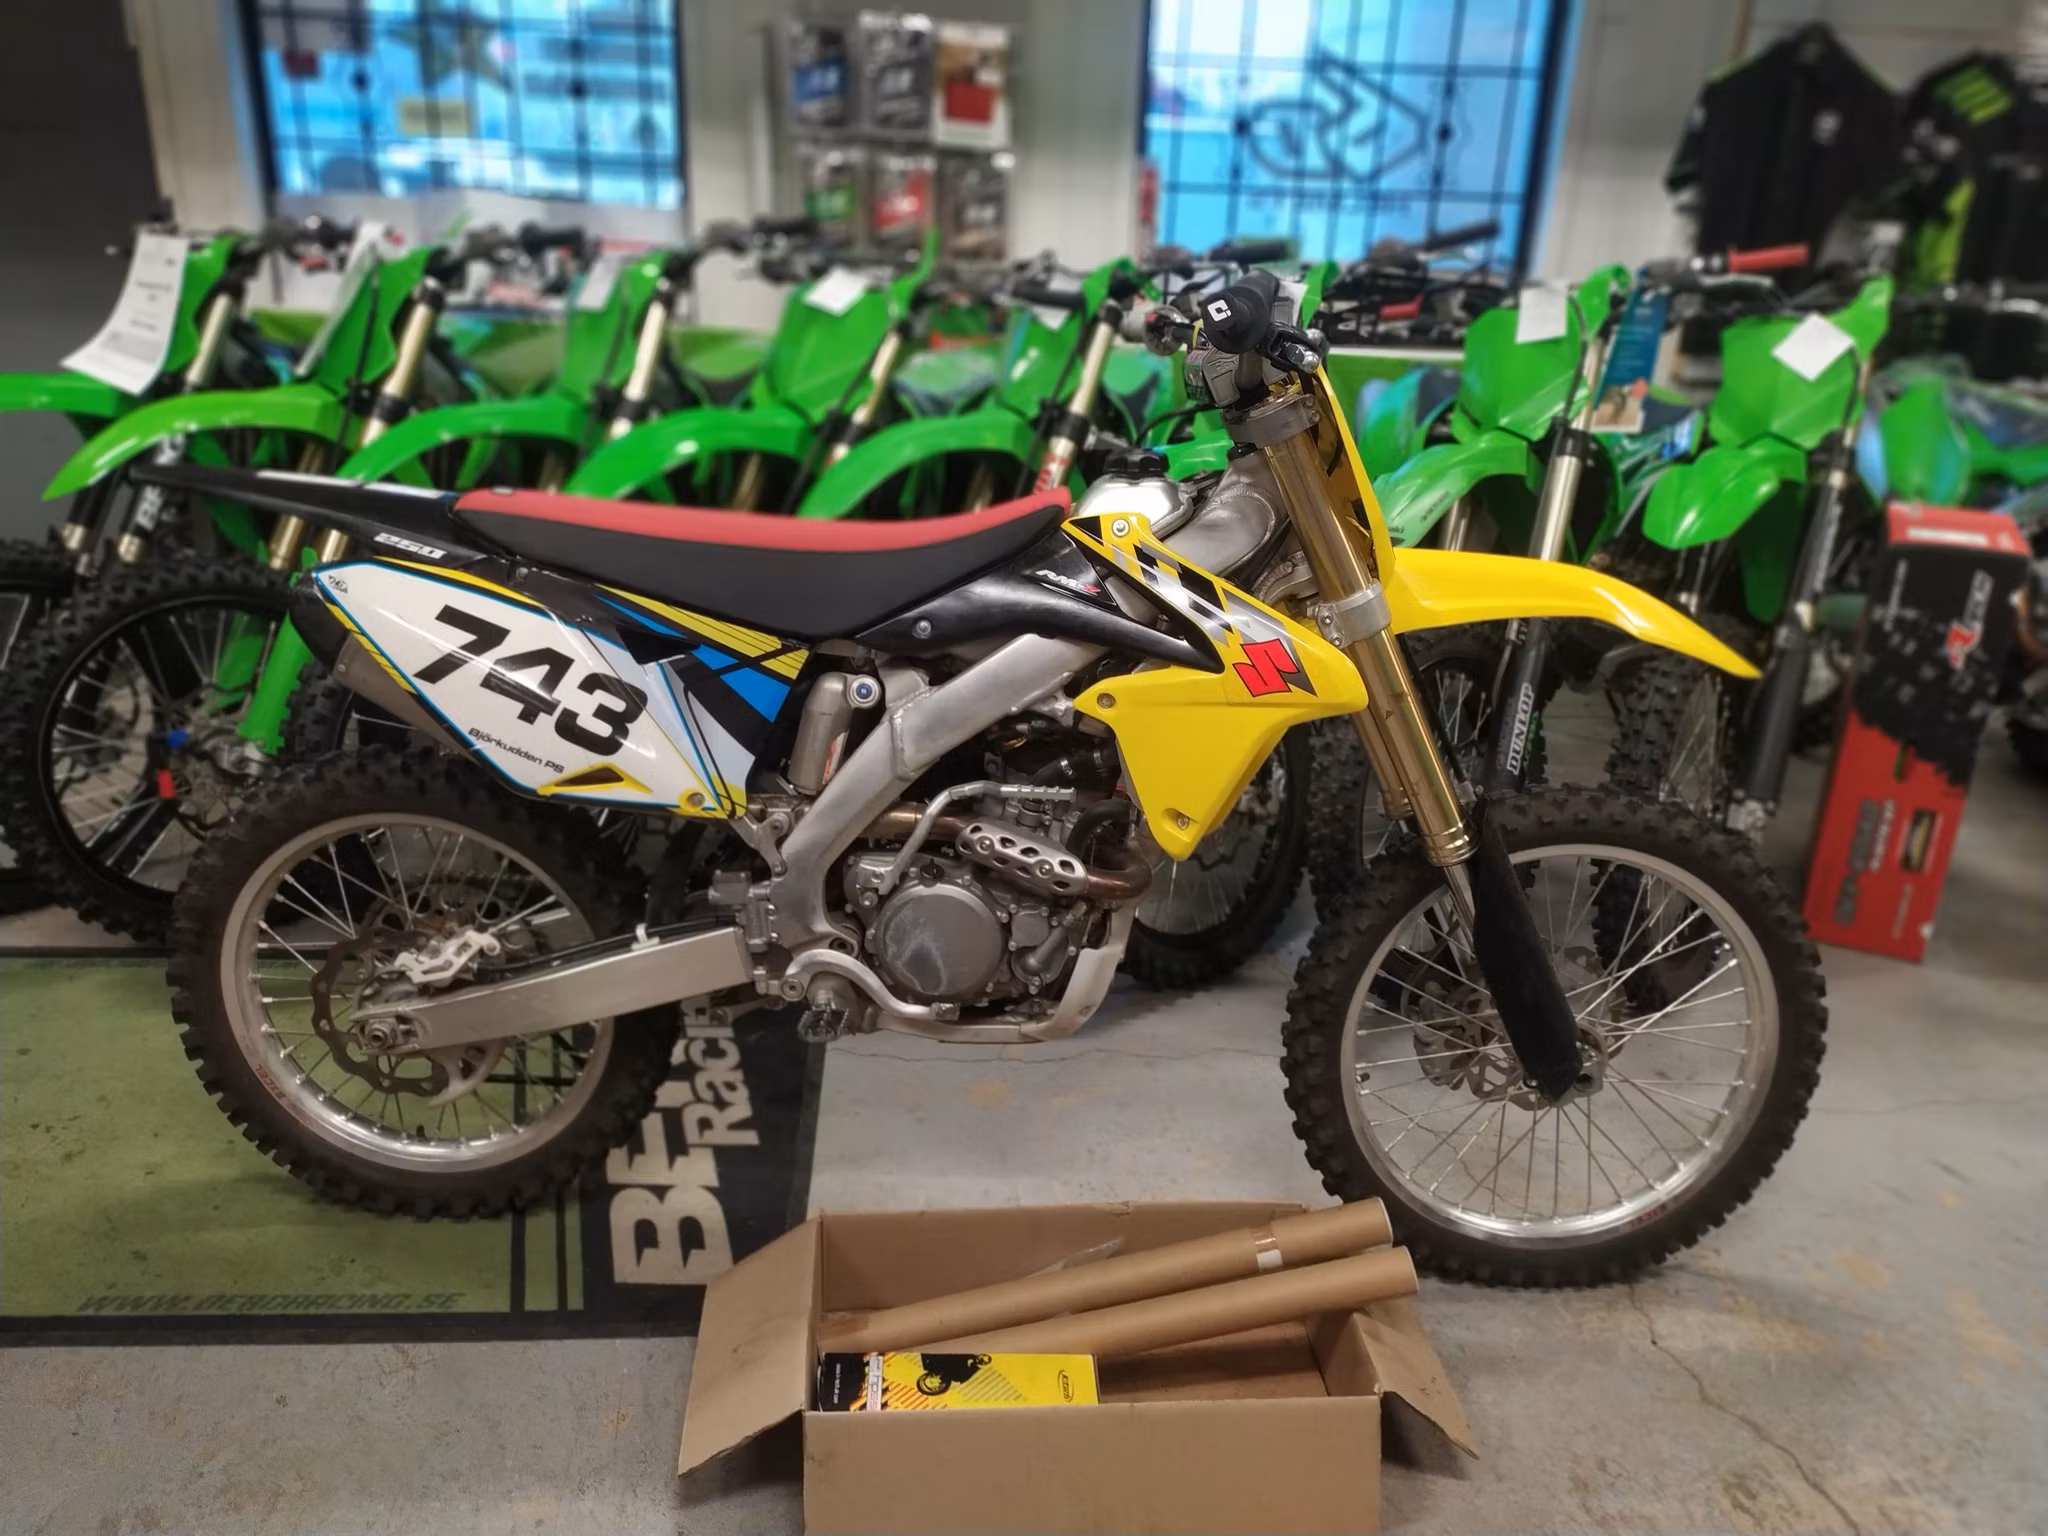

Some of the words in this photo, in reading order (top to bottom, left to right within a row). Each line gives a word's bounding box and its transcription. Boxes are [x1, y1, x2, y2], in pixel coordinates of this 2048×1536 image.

[373, 532, 448, 560] 250
[412, 604, 648, 757] 743
[467, 727, 543, 766] Björkudden
[544, 760, 565, 774] PS
[1506, 682, 1535, 776] DUNLOP
